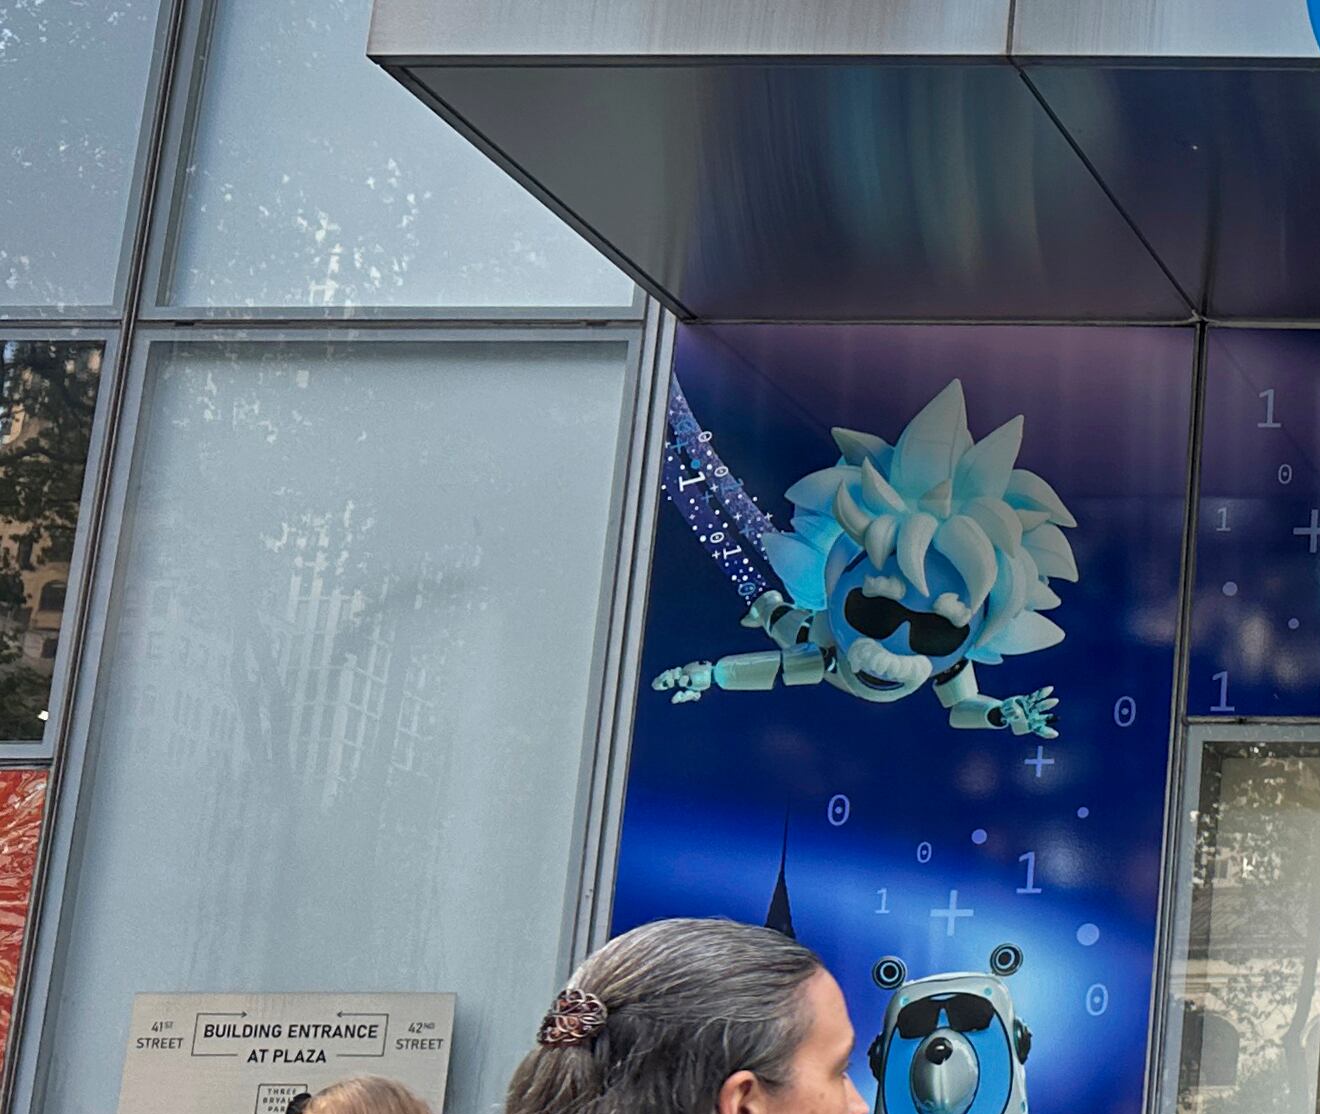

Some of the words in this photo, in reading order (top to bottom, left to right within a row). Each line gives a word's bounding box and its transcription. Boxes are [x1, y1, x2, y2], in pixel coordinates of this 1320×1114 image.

[1257, 388, 1281, 428] 1
[1277, 463, 1292, 483] 0
[1215, 506, 1231, 531] 1
[1209, 670, 1235, 711] 1
[1113, 695, 1136, 727] 0
[827, 794, 850, 826] 0
[916, 841, 931, 863] 0
[1016, 851, 1042, 893] 1
[874, 888, 890, 913] 1
[1085, 983, 1108, 1016] 0
[136, 1037, 185, 1050] STREET
[203, 1023, 282, 1039] BUILDING
[287, 1023, 379, 1040] ENTRANCE
[395, 1038, 444, 1050] STREET
[246, 1048, 270, 1064] AT
[272, 1048, 327, 1064] PLAZA
[267, 1105, 286, 1114] PAR
